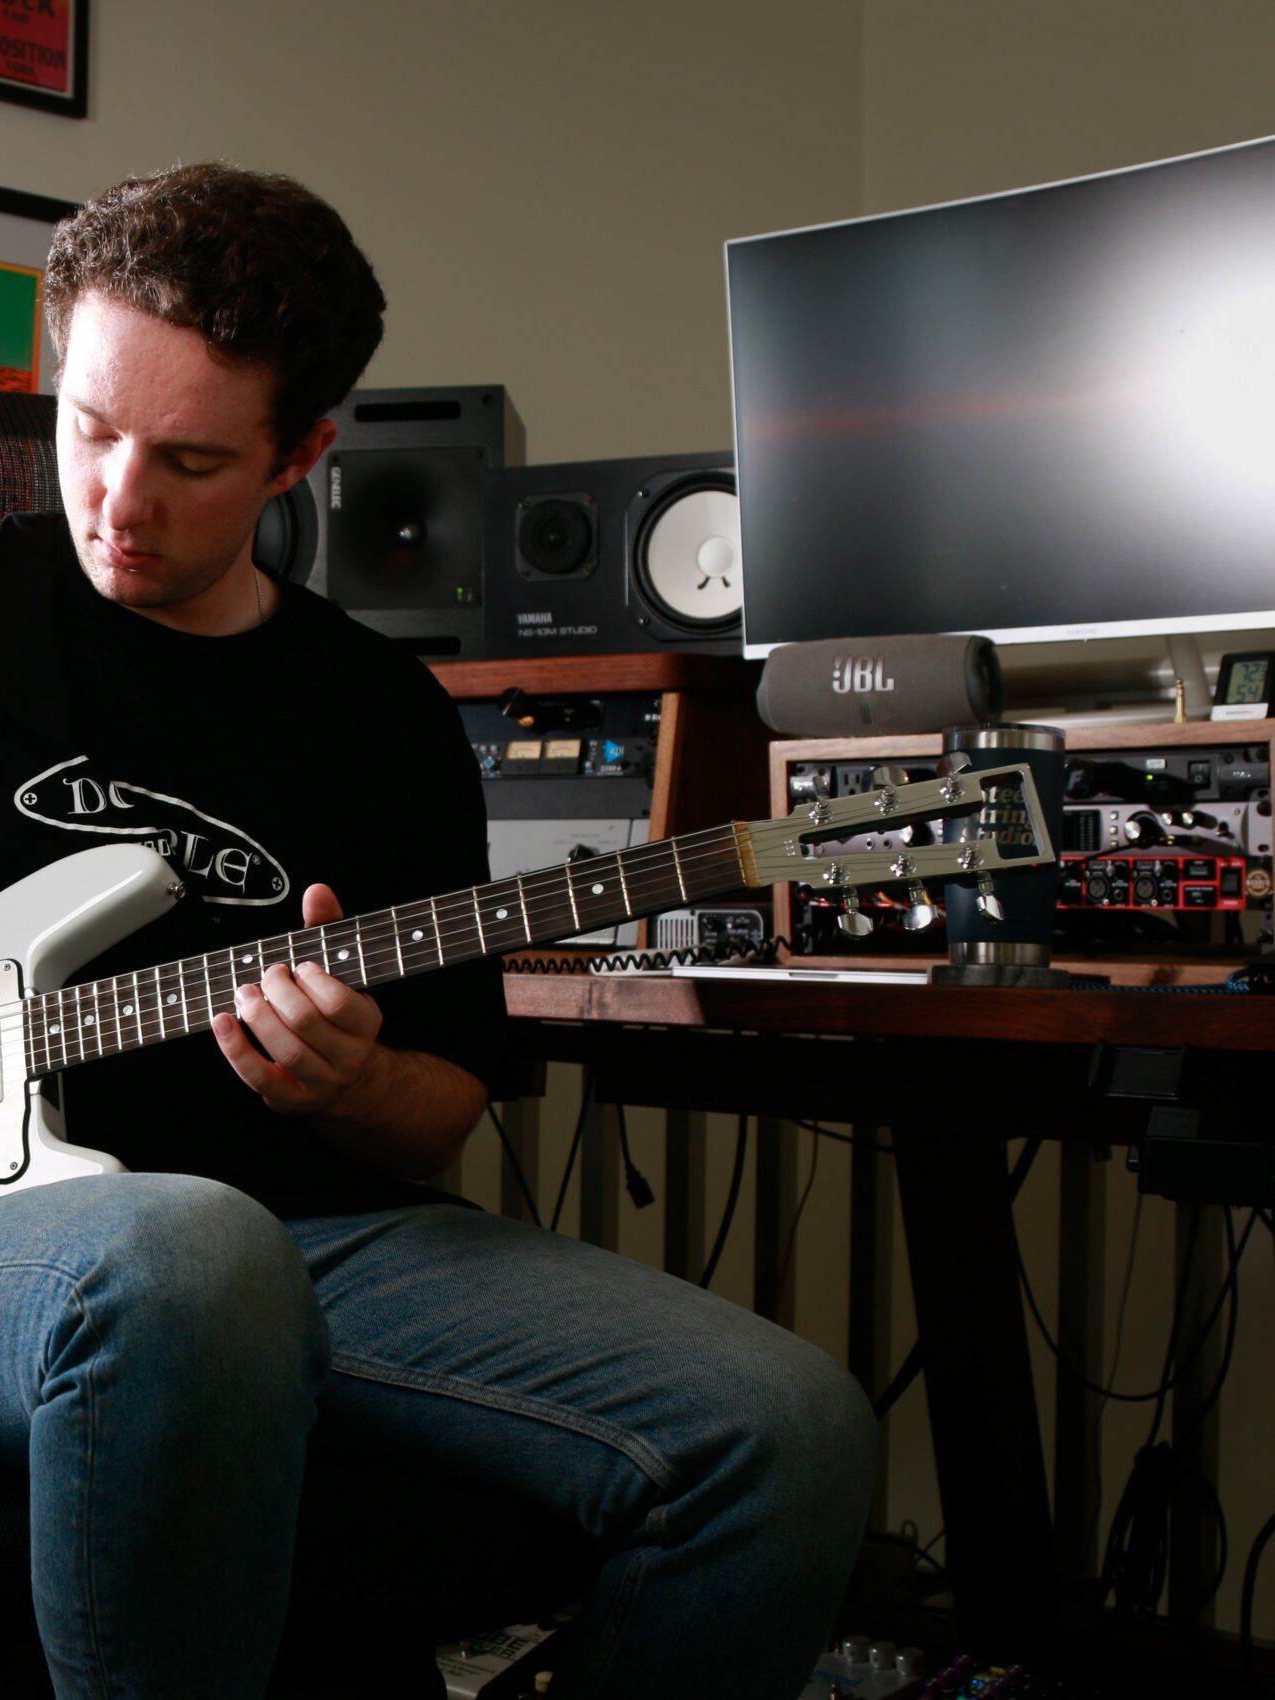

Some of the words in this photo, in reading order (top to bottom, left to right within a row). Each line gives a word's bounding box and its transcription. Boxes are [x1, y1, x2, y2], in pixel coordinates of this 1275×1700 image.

[517, 612, 553, 624] YAMAHA
[559, 625, 598, 635] STUDIO
[832, 656, 895, 694] JBL
